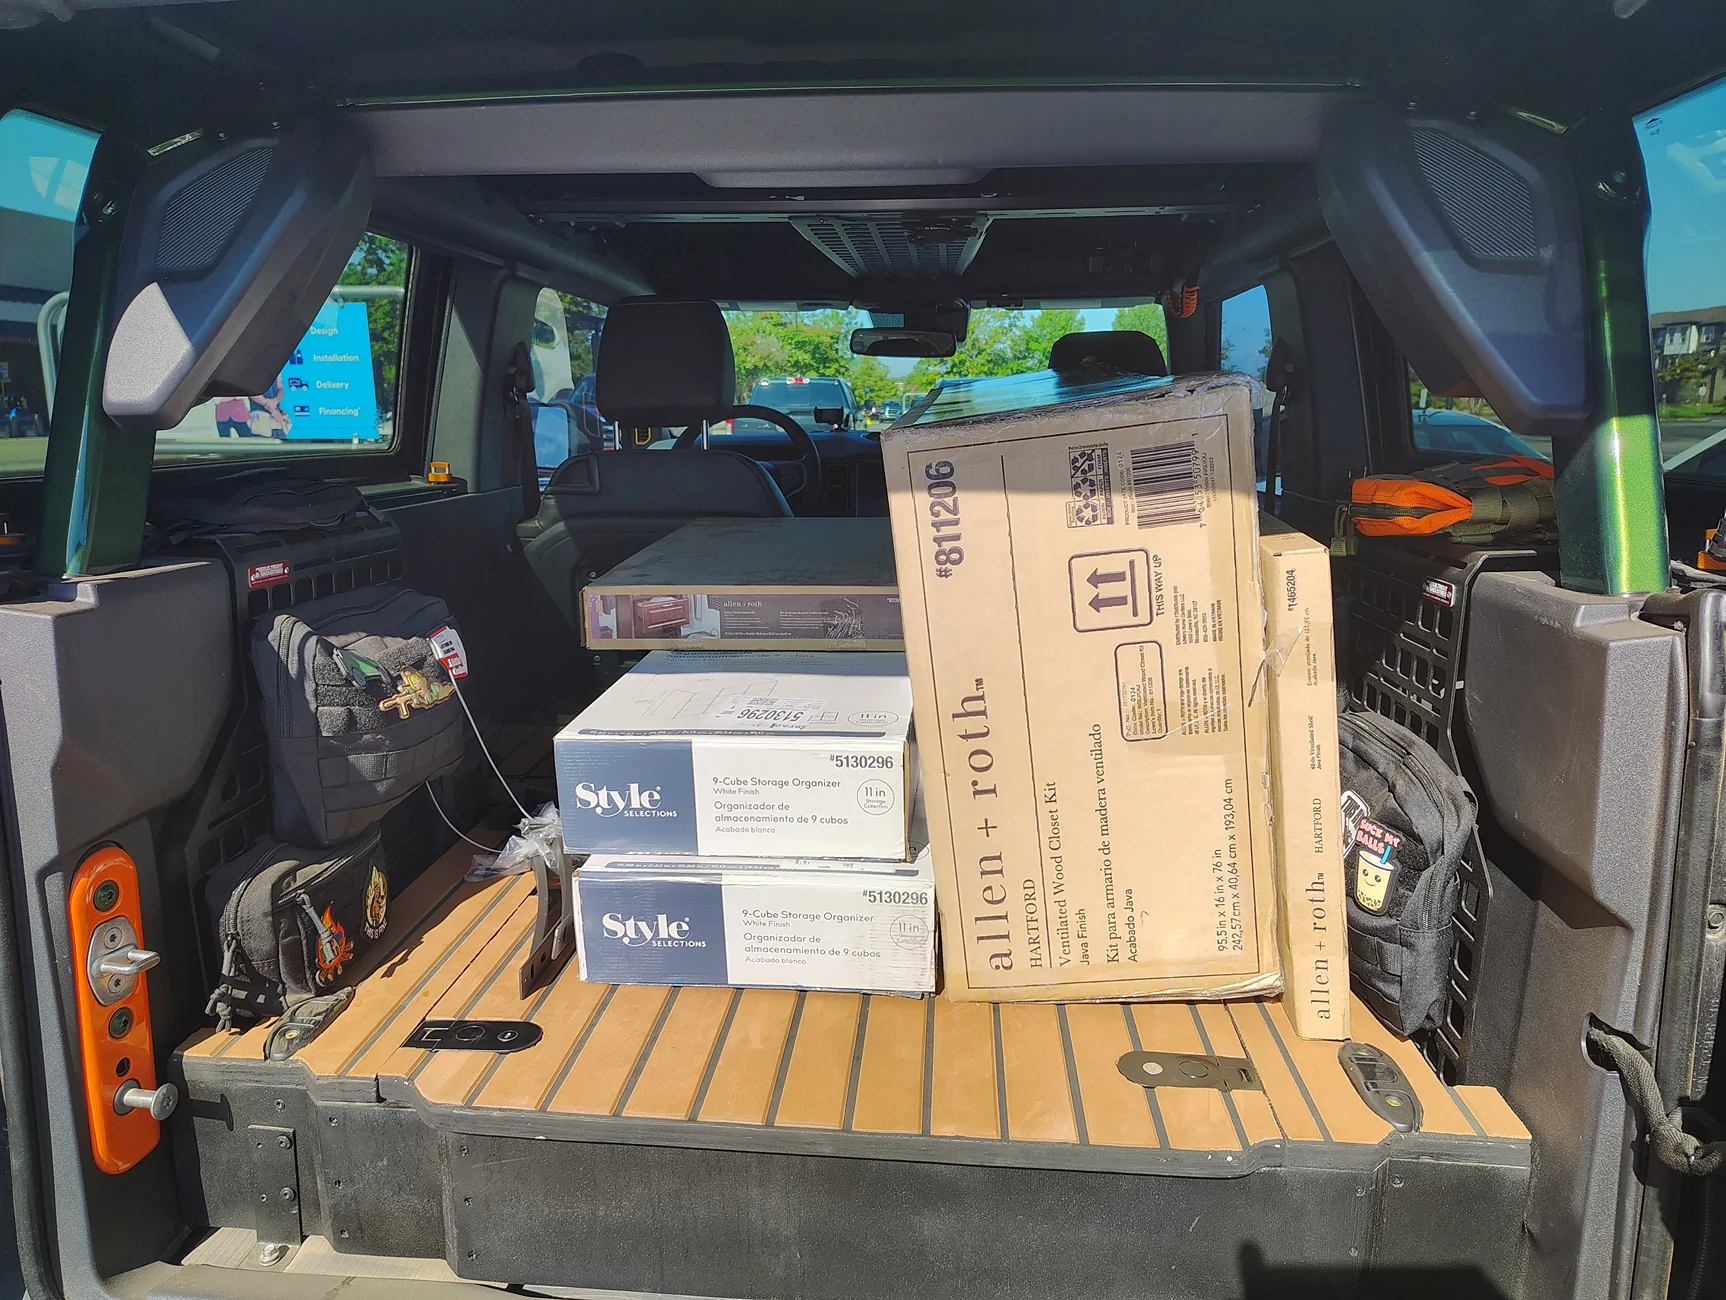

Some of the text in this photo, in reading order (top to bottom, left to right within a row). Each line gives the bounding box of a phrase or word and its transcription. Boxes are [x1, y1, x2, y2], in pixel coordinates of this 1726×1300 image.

[311, 327, 338, 336] Design
[313, 354, 359, 362] Installation
[316, 381, 349, 390] Delivery
[1192, 450, 1201, 479] 50799
[924, 460, 964, 579] #811206
[1153, 554, 1165, 616] THIS WAY UP
[1286, 569, 1298, 611] #1465204
[737, 708, 804, 721] 5130296
[830, 754, 894, 769] #5130296
[712, 777, 841, 789] 9-Cube Storage Organizer
[1224, 778, 1232, 794] cm
[864, 787, 886, 797] 11 in
[575, 782, 661, 818] Style
[714, 801, 790, 812] Organizador de
[624, 810, 678, 818] SELECTIONS
[715, 814, 848, 825] almacenamiento de 9 cubos
[1223, 798, 1236, 831] 193,04
[977, 817, 997, 838] +
[1312, 798, 1323, 854] HARTFORD
[1360, 819, 1400, 848] SUCK MY
[1089, 723, 1121, 964] Kit para armario de madera ventilado
[1356, 830, 1384, 854] BALLS
[1212, 849, 1222, 858] in
[1228, 844, 1237, 859] cm
[1043, 781, 1072, 967] Ventilated Wood Closet Kit
[1212, 861, 1223, 873] 76
[1227, 862, 1240, 890] 40,64
[862, 889, 928, 905] #5130296
[1214, 885, 1224, 894] in
[1214, 896, 1225, 908] 16
[742, 910, 874, 923] 9-Cube Storage Organizer
[974, 851, 1013, 971] allen
[602, 912, 690, 947] Style
[768, 920, 790, 928] Finish
[909, 922, 920, 932] in
[1022, 878, 1043, 968] HARTFORD
[1123, 888, 1138, 962] Acabado Java
[652, 940, 706, 948] SELECTIONS
[744, 933, 821, 943] Organizador de
[1075, 908, 1090, 966] Java Finish
[745, 945, 881, 958] almacenamiento de 9 cubos
[1315, 941, 1326, 951] +
[1311, 959, 1331, 1020] allen
